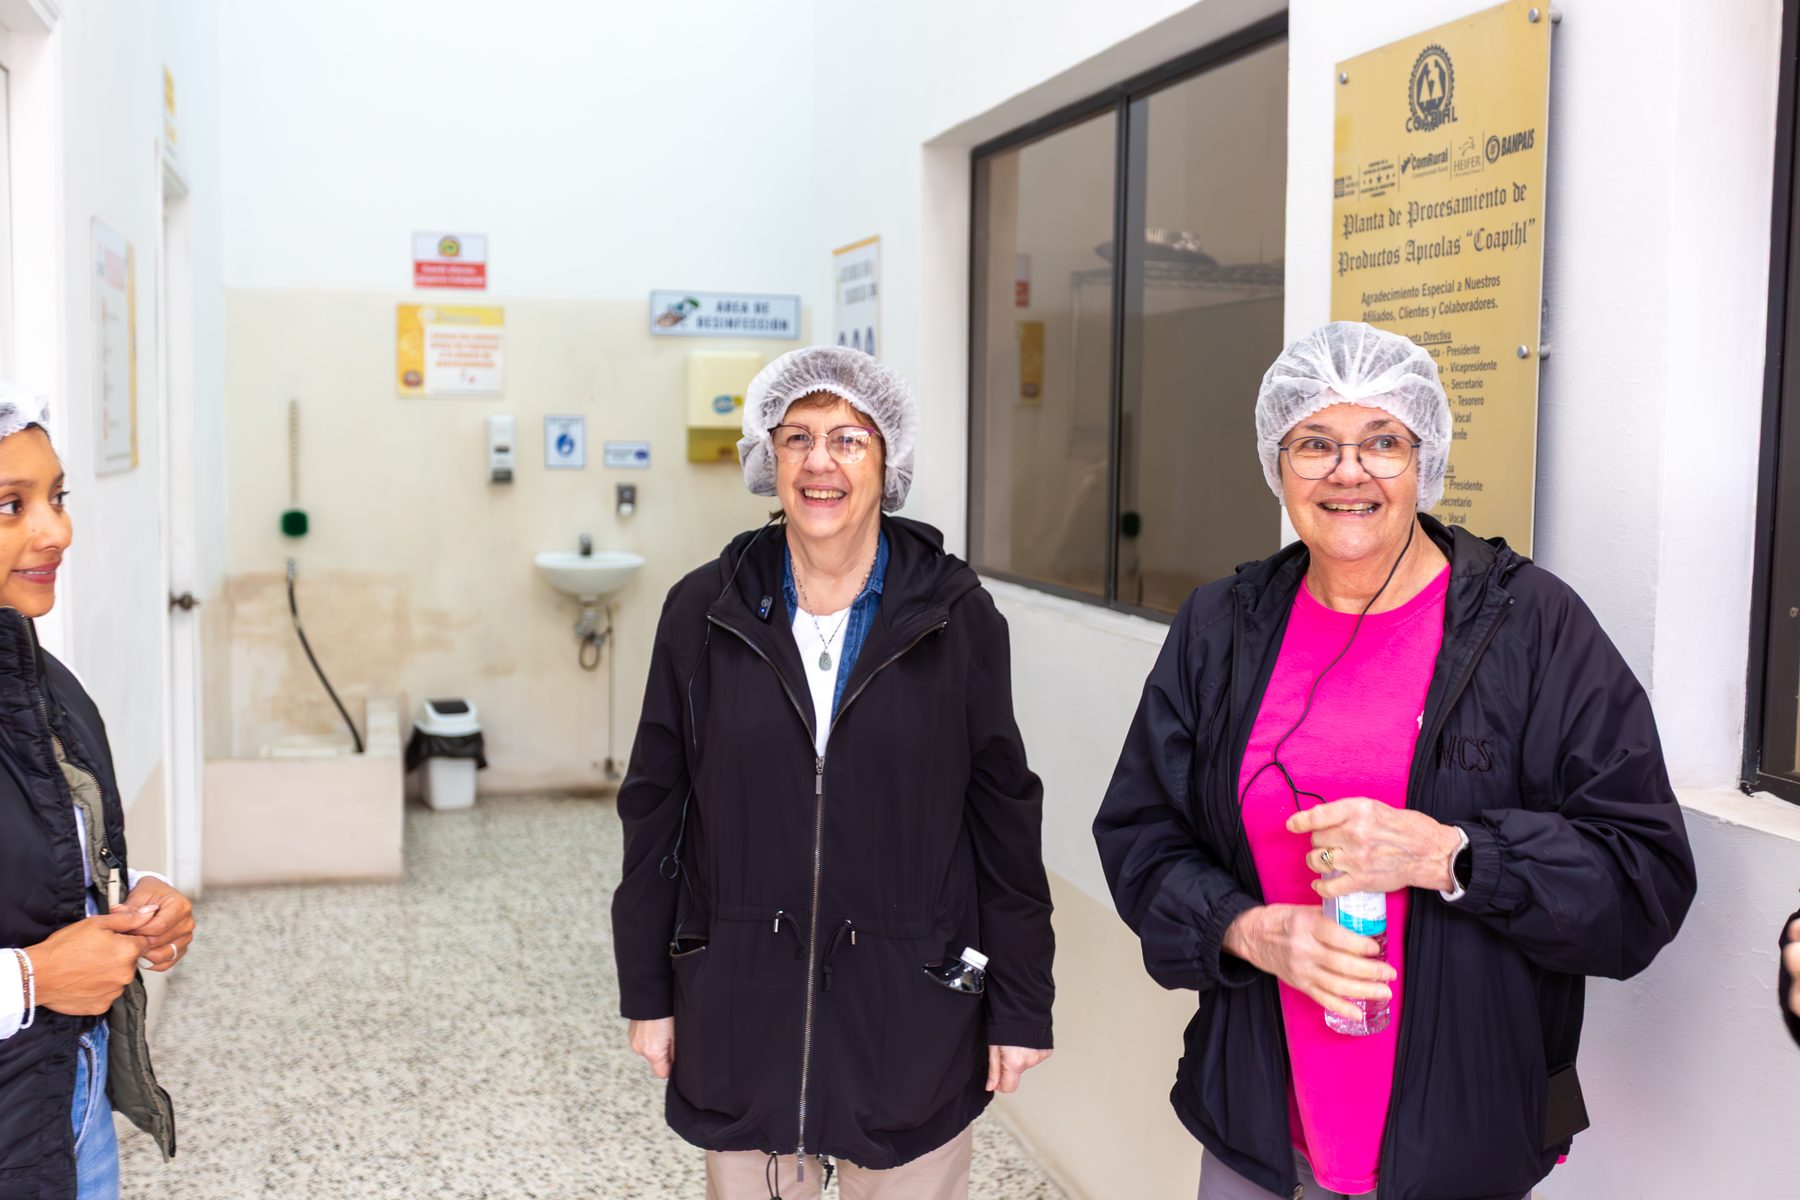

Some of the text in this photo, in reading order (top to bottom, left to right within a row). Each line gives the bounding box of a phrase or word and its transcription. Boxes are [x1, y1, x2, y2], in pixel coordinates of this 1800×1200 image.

[1453, 155, 1481, 172] HEIFER
[1343, 214, 1385, 240] Planta
[1388, 207, 1403, 228] de
[1407, 188, 1507, 228] Procesamiento
[1512, 181, 1528, 203] de
[1338, 246, 1400, 277] Productos
[1361, 285, 1420, 306] Agradecimiento
[1422, 281, 1455, 300] Especial
[1465, 275, 1501, 291] Nuestros
[1399, 304, 1429, 319] Clientes
[1439, 298, 1498, 316] Colaboradores.
[1424, 330, 1452, 342] Directiva
[1447, 344, 1480, 356] Presidente
[1450, 360, 1498, 374] Vicepresidente
[1451, 378, 1483, 390] Secretario
[1458, 395, 1484, 406] Tesorero
[1454, 411, 1472, 423] Vocal
[1449, 480, 1483, 491] Presidente
[1440, 497, 1472, 508] Secretario
[1449, 512, 1466, 524] Vocal
